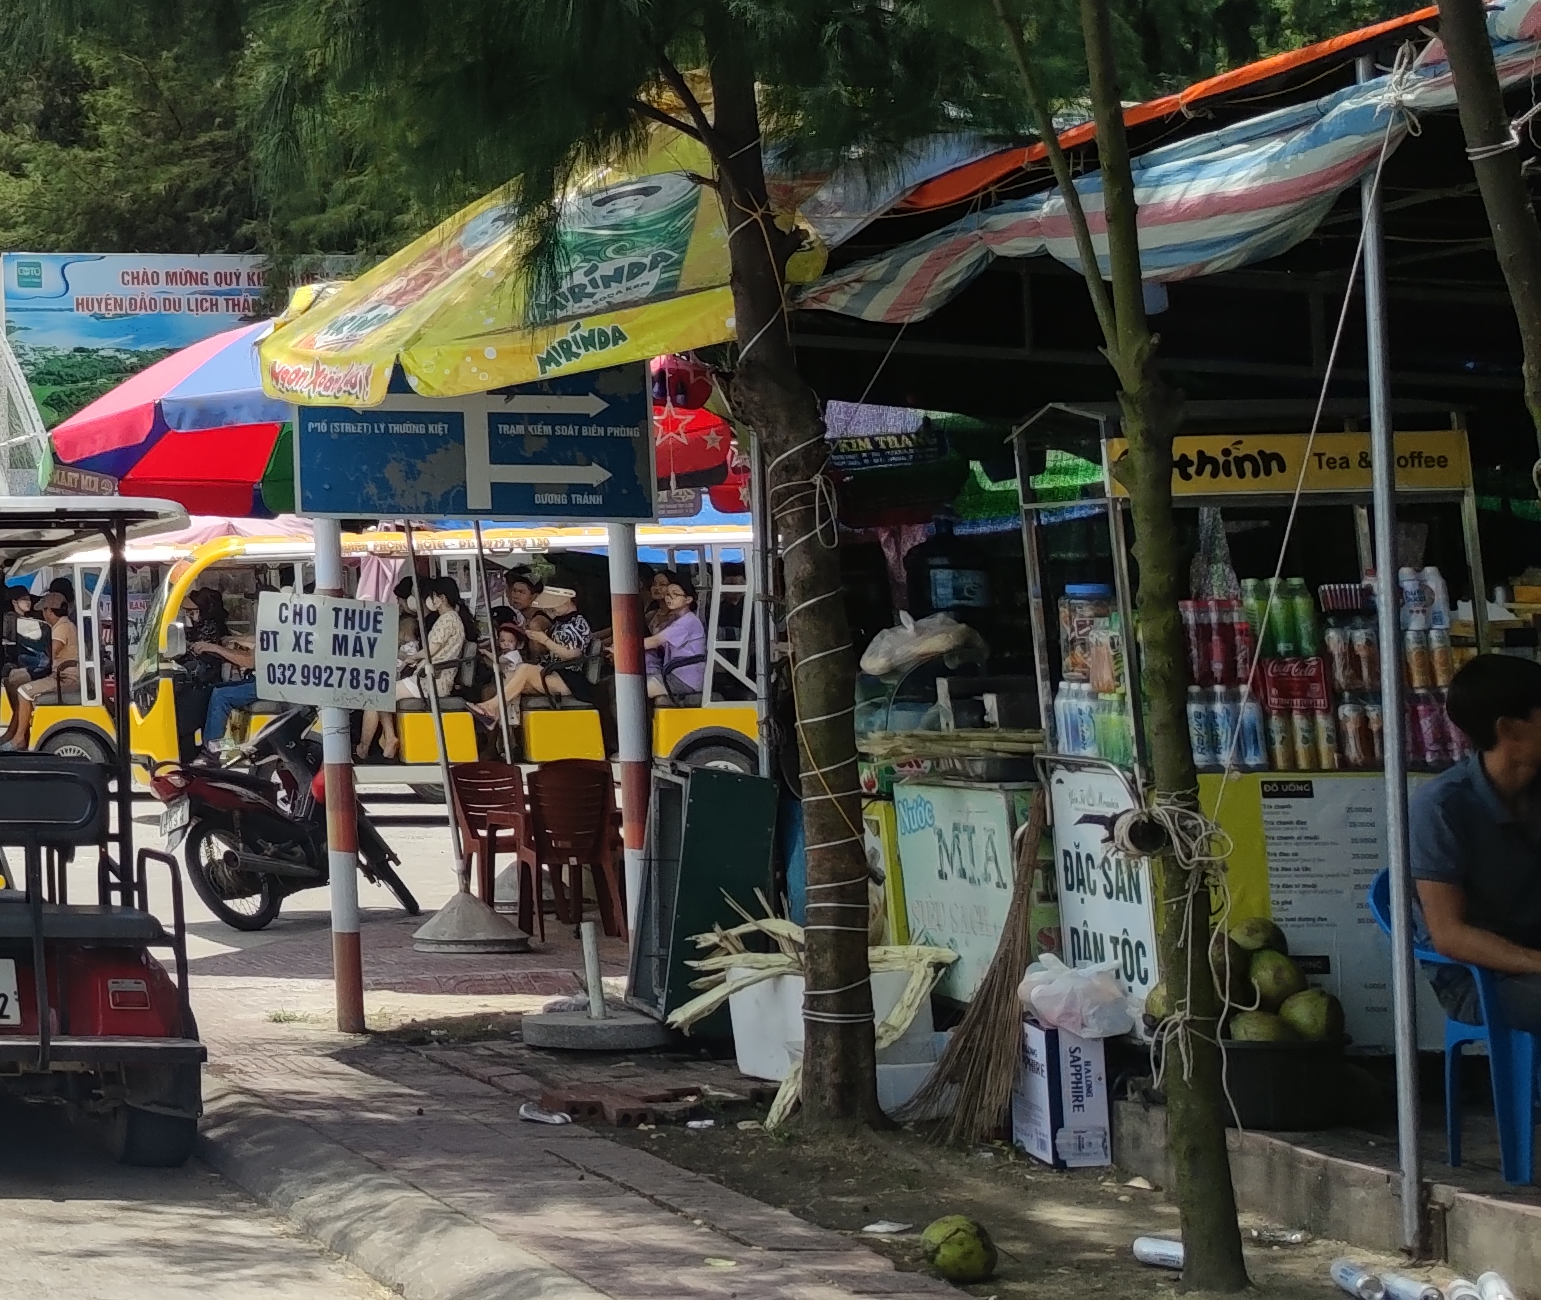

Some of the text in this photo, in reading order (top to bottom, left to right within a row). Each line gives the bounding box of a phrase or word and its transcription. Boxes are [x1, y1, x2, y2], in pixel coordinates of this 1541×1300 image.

[121, 267, 160, 286] CHÀO
[166, 267, 209, 286] MỪNG
[213, 268, 242, 287] QUÝ
[75, 293, 124, 314] HUYỆN
[128, 291, 158, 313] ĐẢO
[162, 297, 182, 313] DU
[186, 297, 218, 316] LỊCH
[1313, 452, 1351, 470] Tea
[1395, 450, 1449, 469] offee
[278, 602, 383, 634] CHO THUÊ
[291, 629, 314, 654] XE
[331, 631, 379, 659] MÁY
[1062, 841, 1097, 905] ĐẶC
[1068, 1045, 1085, 1113] SAPPHIRE
